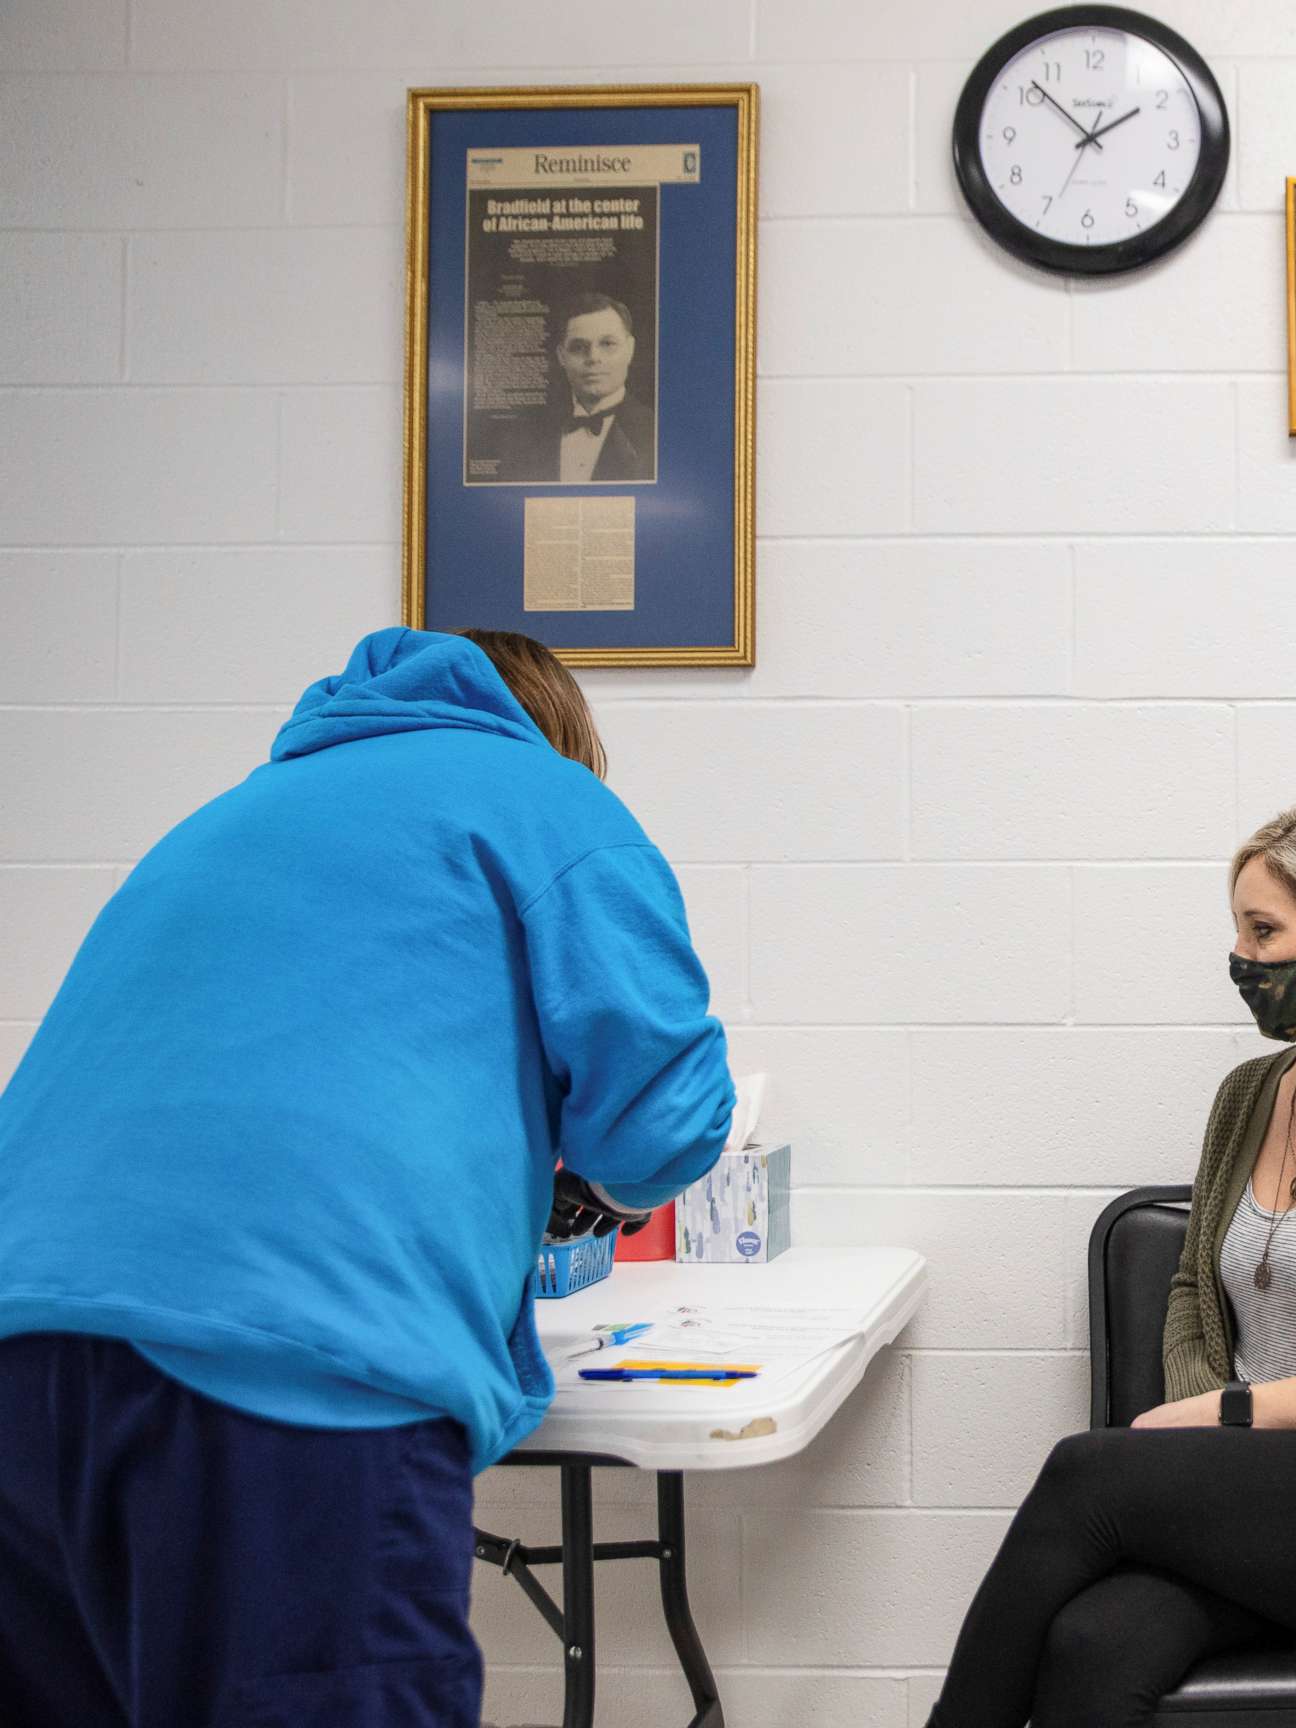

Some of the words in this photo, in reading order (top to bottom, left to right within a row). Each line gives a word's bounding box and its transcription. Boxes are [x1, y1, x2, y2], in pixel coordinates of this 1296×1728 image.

[1084, 49, 1105, 70] 12
[1043, 62, 1062, 82] 11
[1018, 86, 1046, 107] 10
[1155, 89, 1169, 110] 2
[1003, 126, 1016, 146] 9
[1167, 130, 1180, 150] 3
[534, 153, 631, 174] Reminisce
[1010, 164, 1023, 186] 8
[1153, 169, 1166, 188] 4
[552, 199, 567, 214] at
[568, 197, 592, 214] the
[593, 198, 641, 214] center
[1041, 195, 1053, 216] 7
[1124, 197, 1138, 218] 5
[482, 216, 498, 233] of
[498, 215, 619, 232] African-American
[620, 214, 645, 230] life
[1080, 209, 1095, 228] 6
